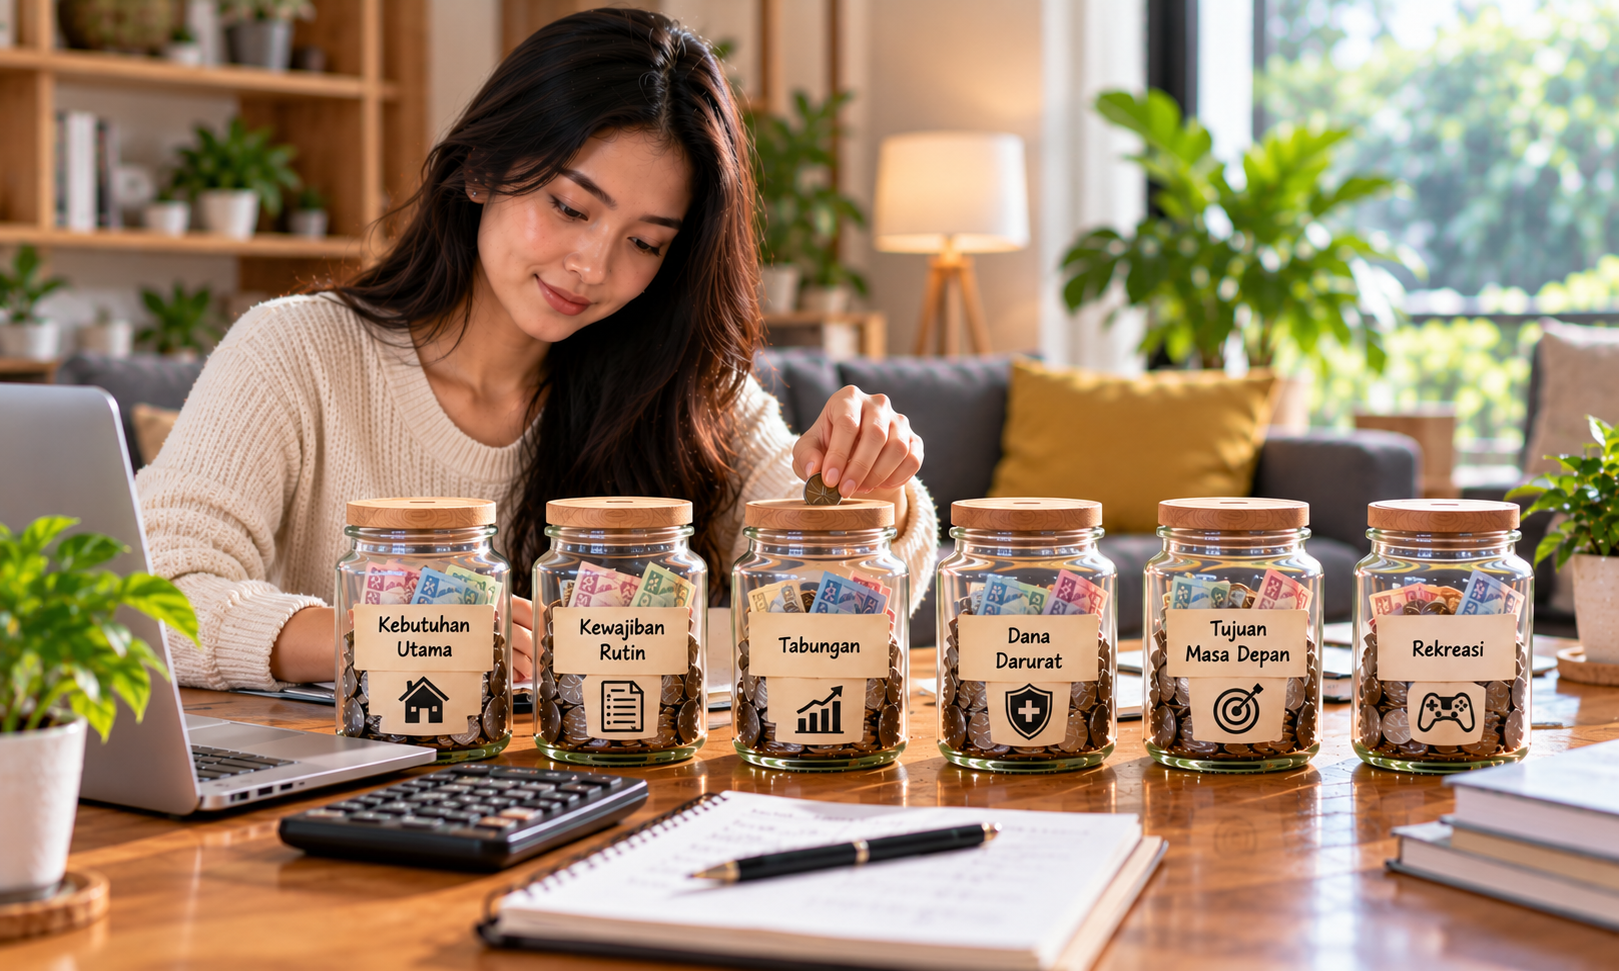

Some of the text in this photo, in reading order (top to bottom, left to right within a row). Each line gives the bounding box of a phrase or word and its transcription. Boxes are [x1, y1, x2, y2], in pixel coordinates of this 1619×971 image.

[378, 614, 470, 633] Kebutuhan
[579, 617, 665, 642] Kewajiban
[1209, 619, 1267, 643] Tujuan
[1008, 626, 1051, 645] Dana
[397, 640, 453, 658] Utama
[599, 643, 646, 661] Rutin
[778, 635, 861, 660] Tabungan
[1185, 644, 1290, 669] Masa Depan
[1412, 639, 1485, 658] Rekreasi
[995, 651, 1063, 670] Darurat
